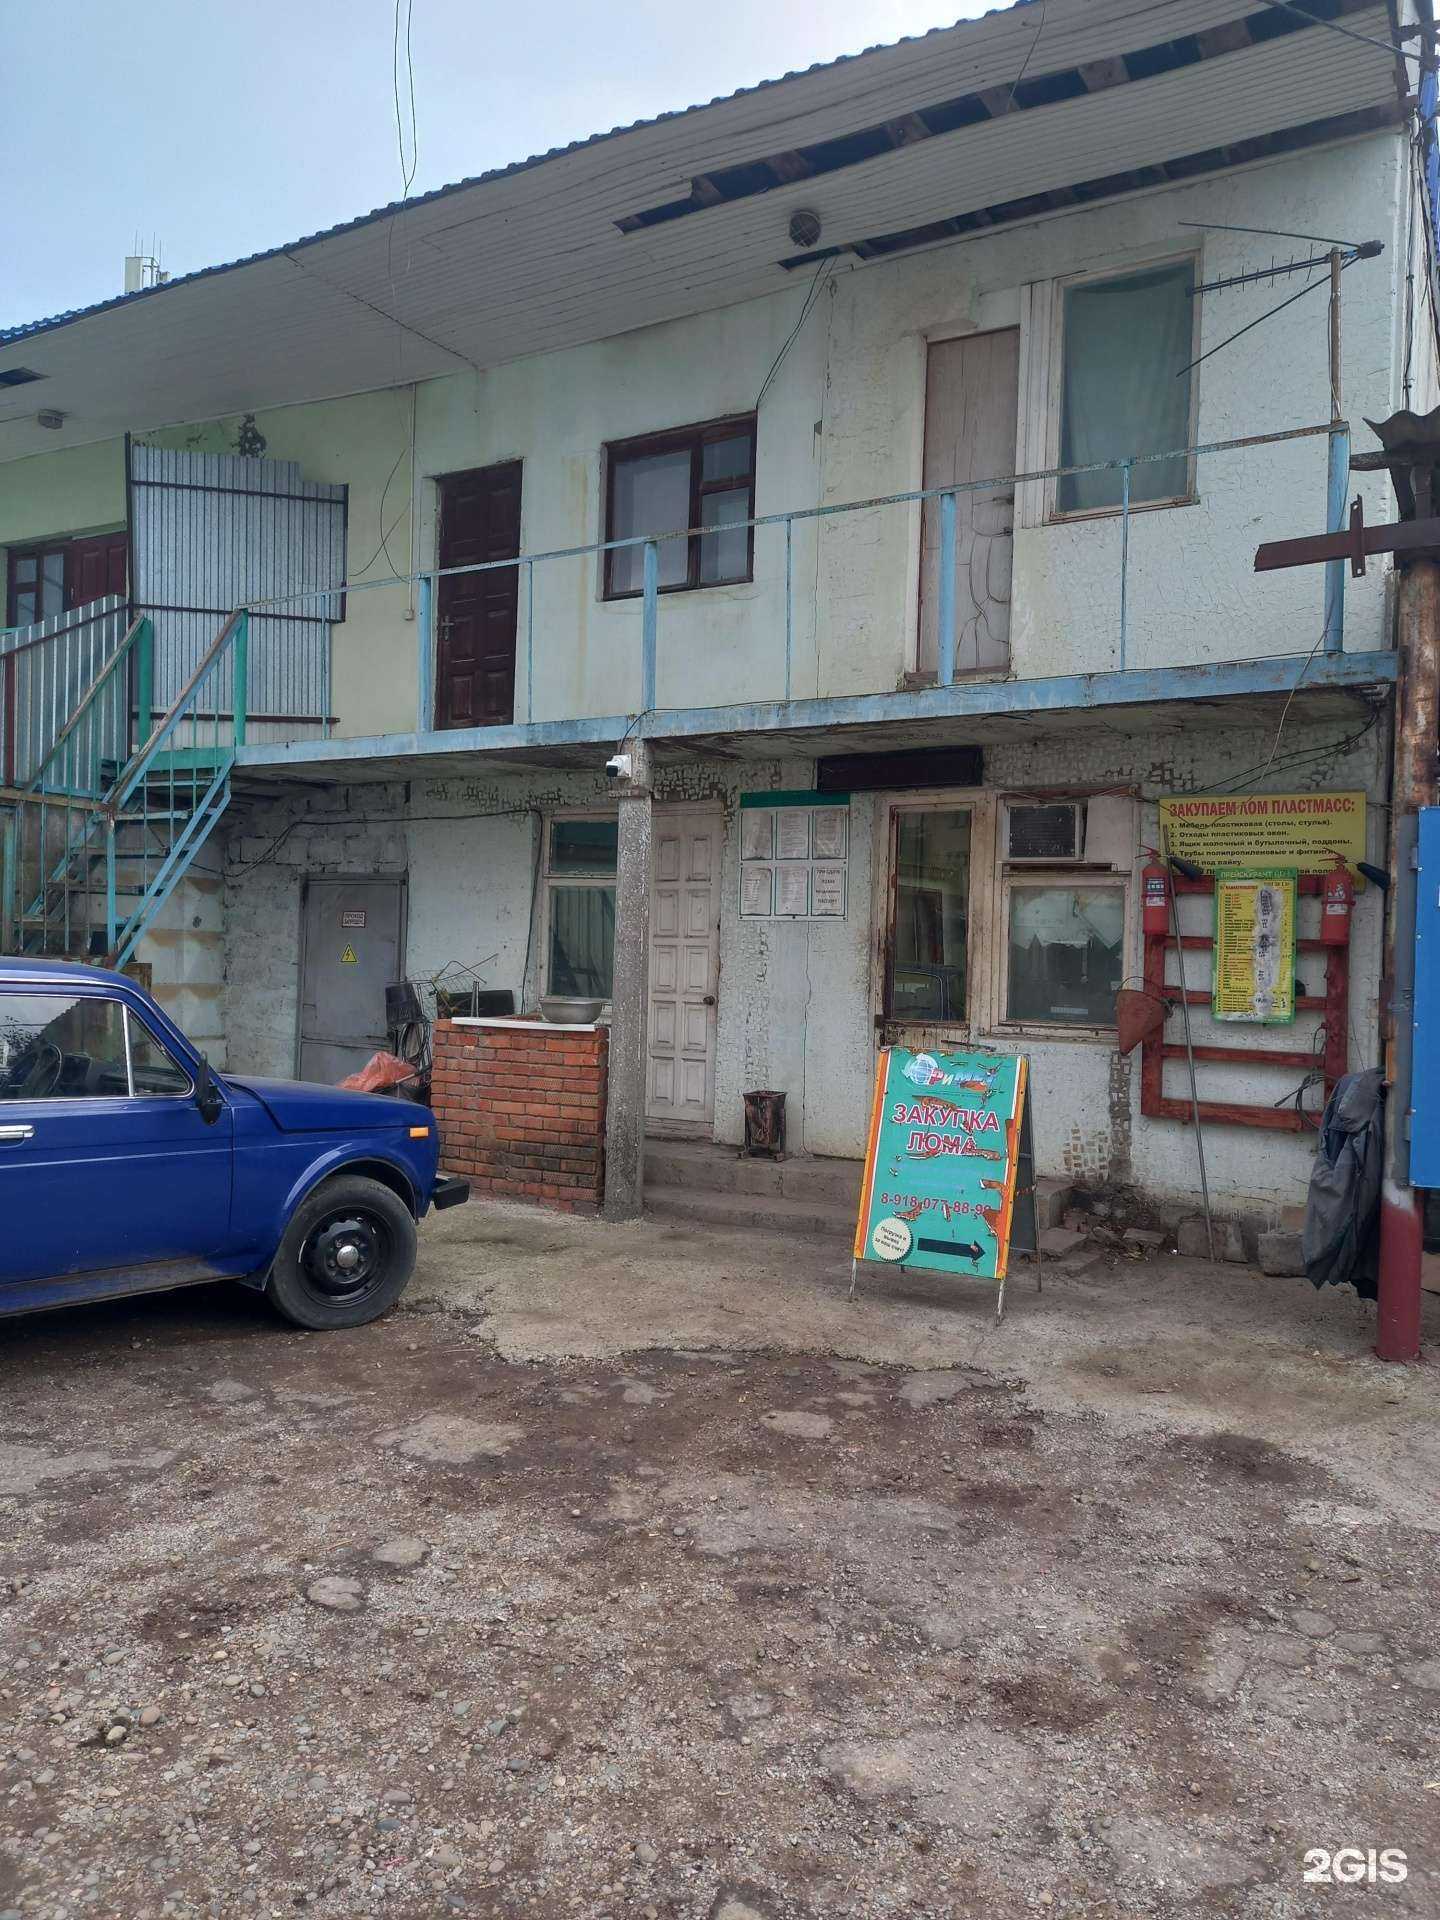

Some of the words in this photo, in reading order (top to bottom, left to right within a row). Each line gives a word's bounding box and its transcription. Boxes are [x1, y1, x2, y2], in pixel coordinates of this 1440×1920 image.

[1169, 802, 1237, 817] ЗАКУПАЕМ
[1240, 800, 1268, 815] ЛОМ
[1271, 798, 1355, 814] ПЛАСТМАСС:
[1210, 821, 1263, 829] пластиковая
[1264, 820, 1297, 828] (столы,
[1254, 839, 1310, 847] бутылочный,
[1312, 839, 1353, 847] поддоны.
[1179, 850, 1204, 858] Трубы
[1206, 849, 1287, 857] полипропиленовые
[892, 1103, 1000, 1132] ЗАКУПКА
[906, 1131, 978, 1155] ЛОМА
